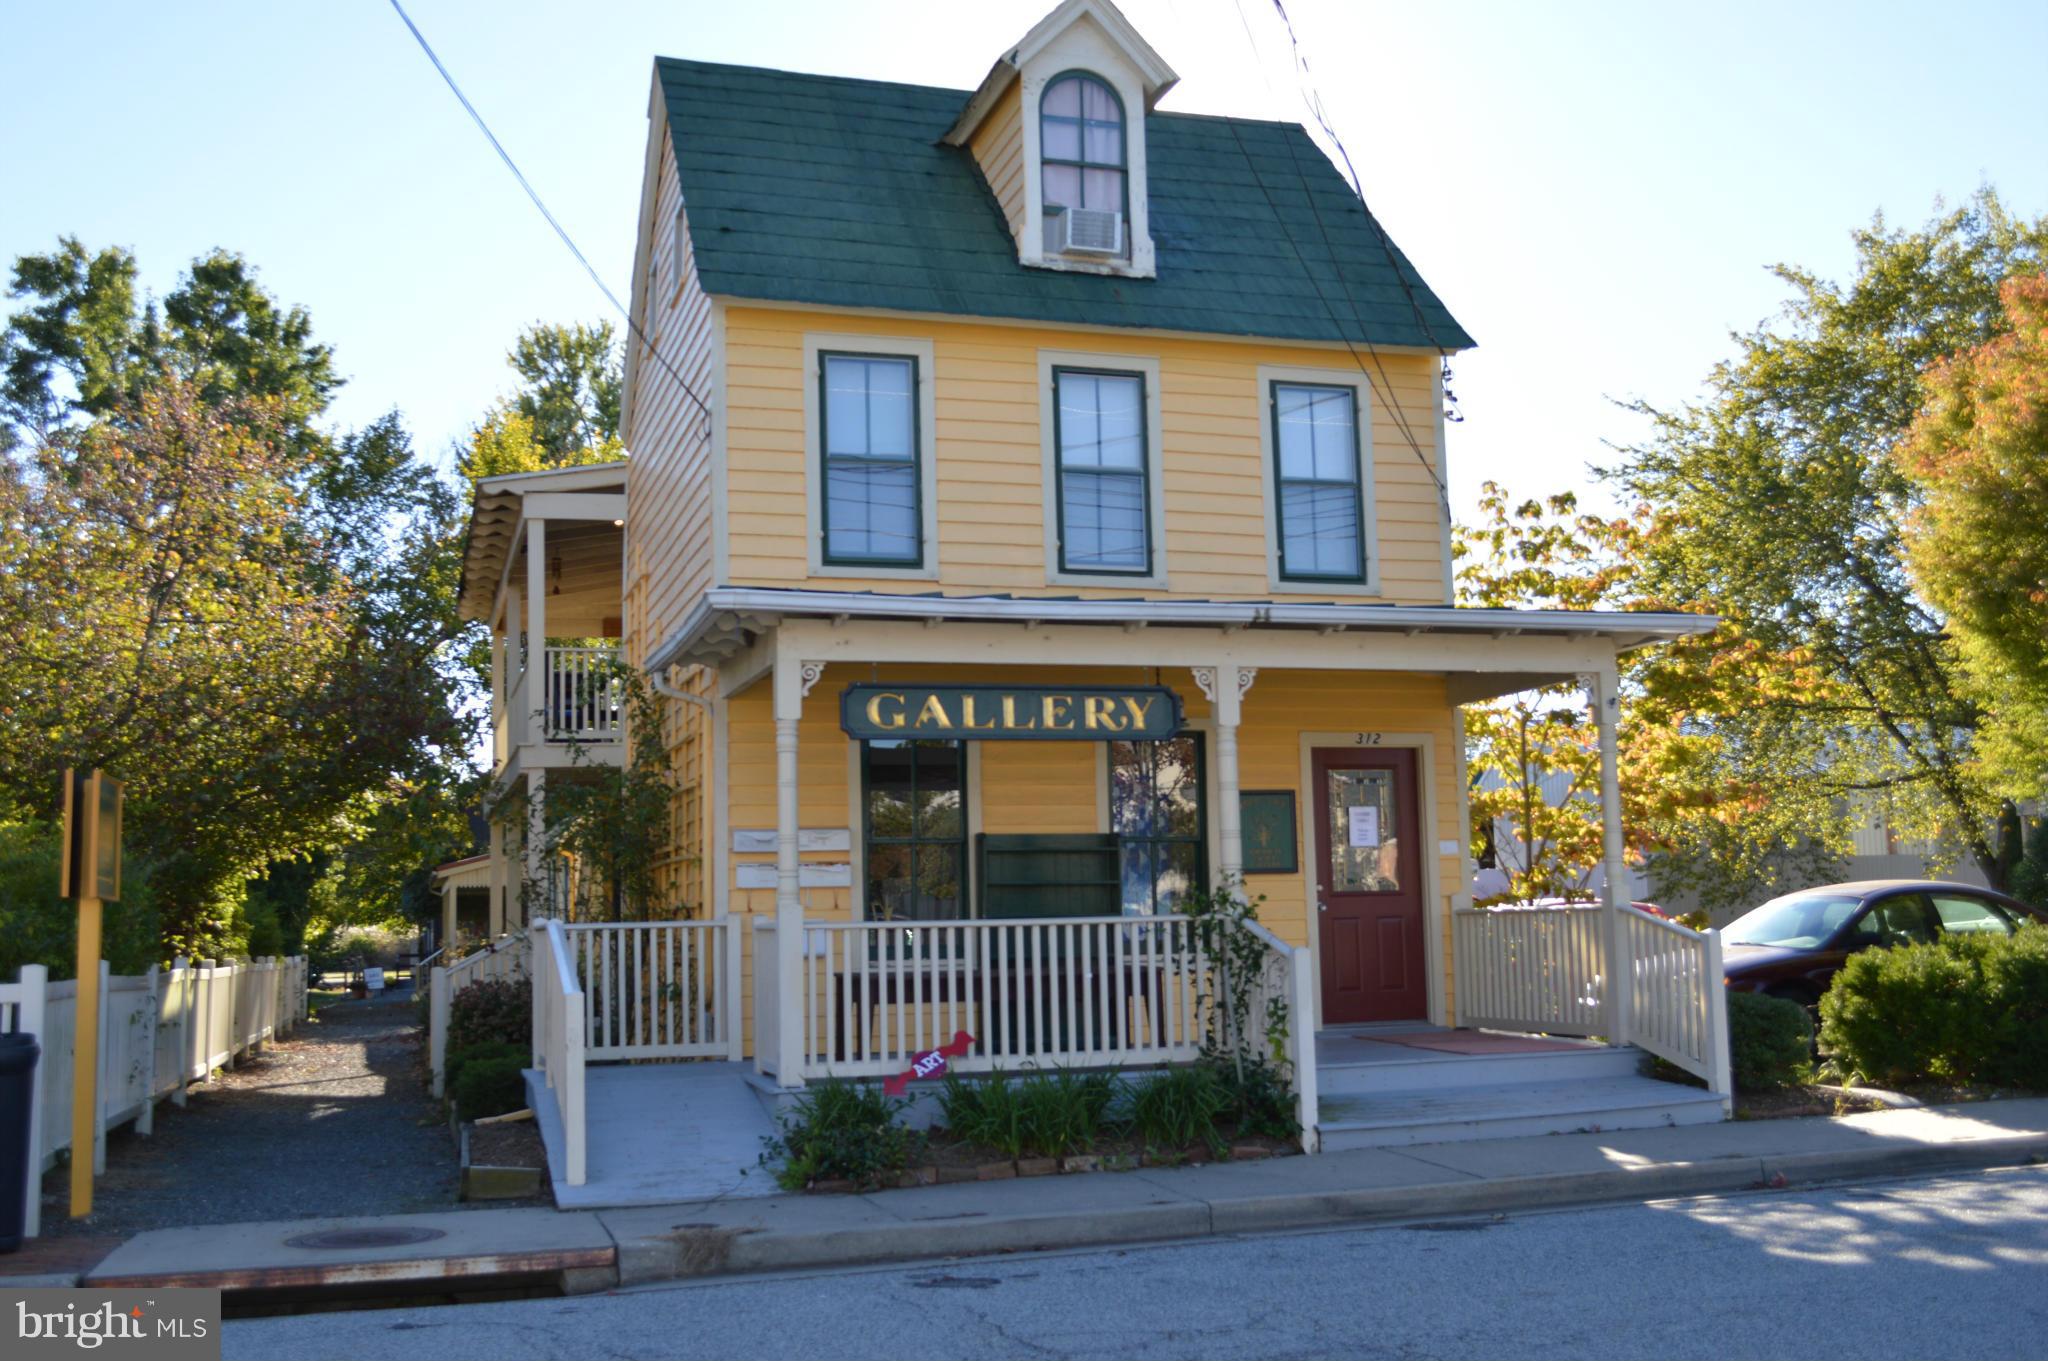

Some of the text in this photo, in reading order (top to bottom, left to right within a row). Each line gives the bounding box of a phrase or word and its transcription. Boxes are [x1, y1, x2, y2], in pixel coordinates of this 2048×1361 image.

[865, 692, 1156, 731] GALLERY
[1355, 732, 1382, 745] 312
[912, 1050, 945, 1078] ART
